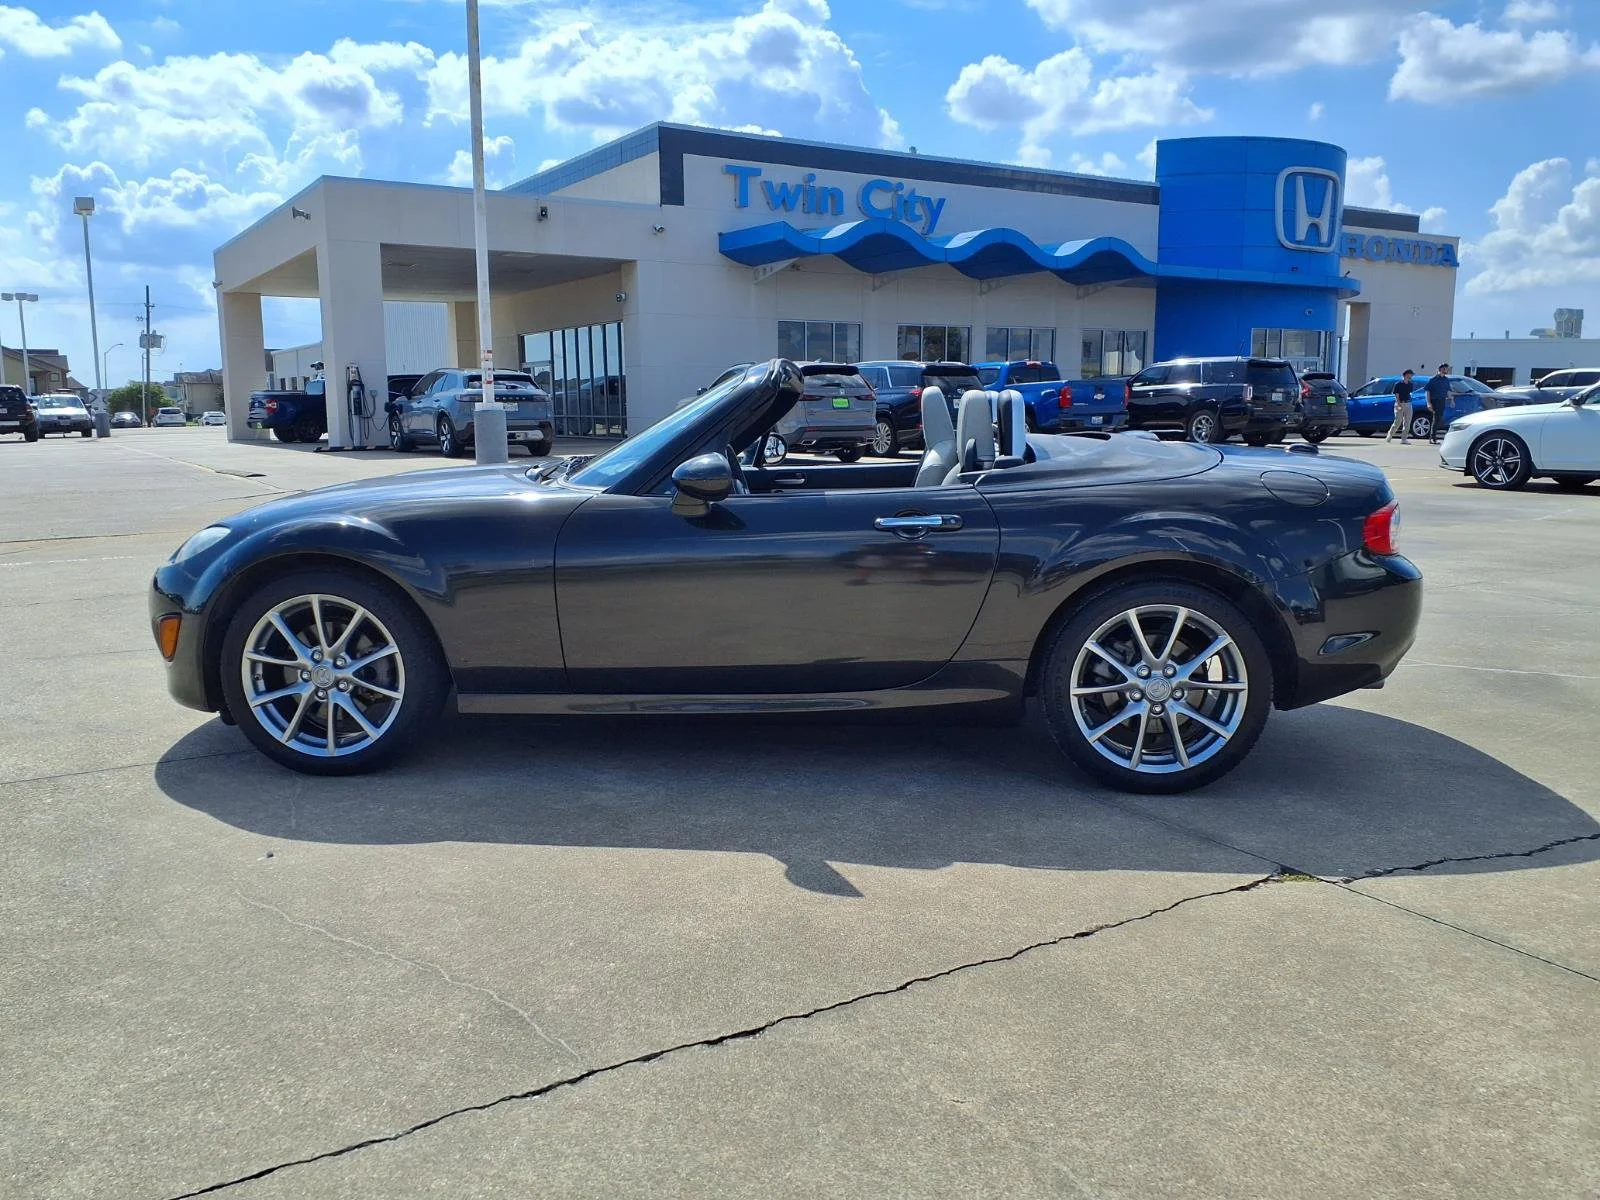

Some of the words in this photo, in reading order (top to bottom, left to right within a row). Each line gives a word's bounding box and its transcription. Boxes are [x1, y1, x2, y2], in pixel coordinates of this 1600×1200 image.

[723, 164, 844, 216] Twin
[857, 178, 946, 236] City
[1340, 232, 1460, 267] HONDA
